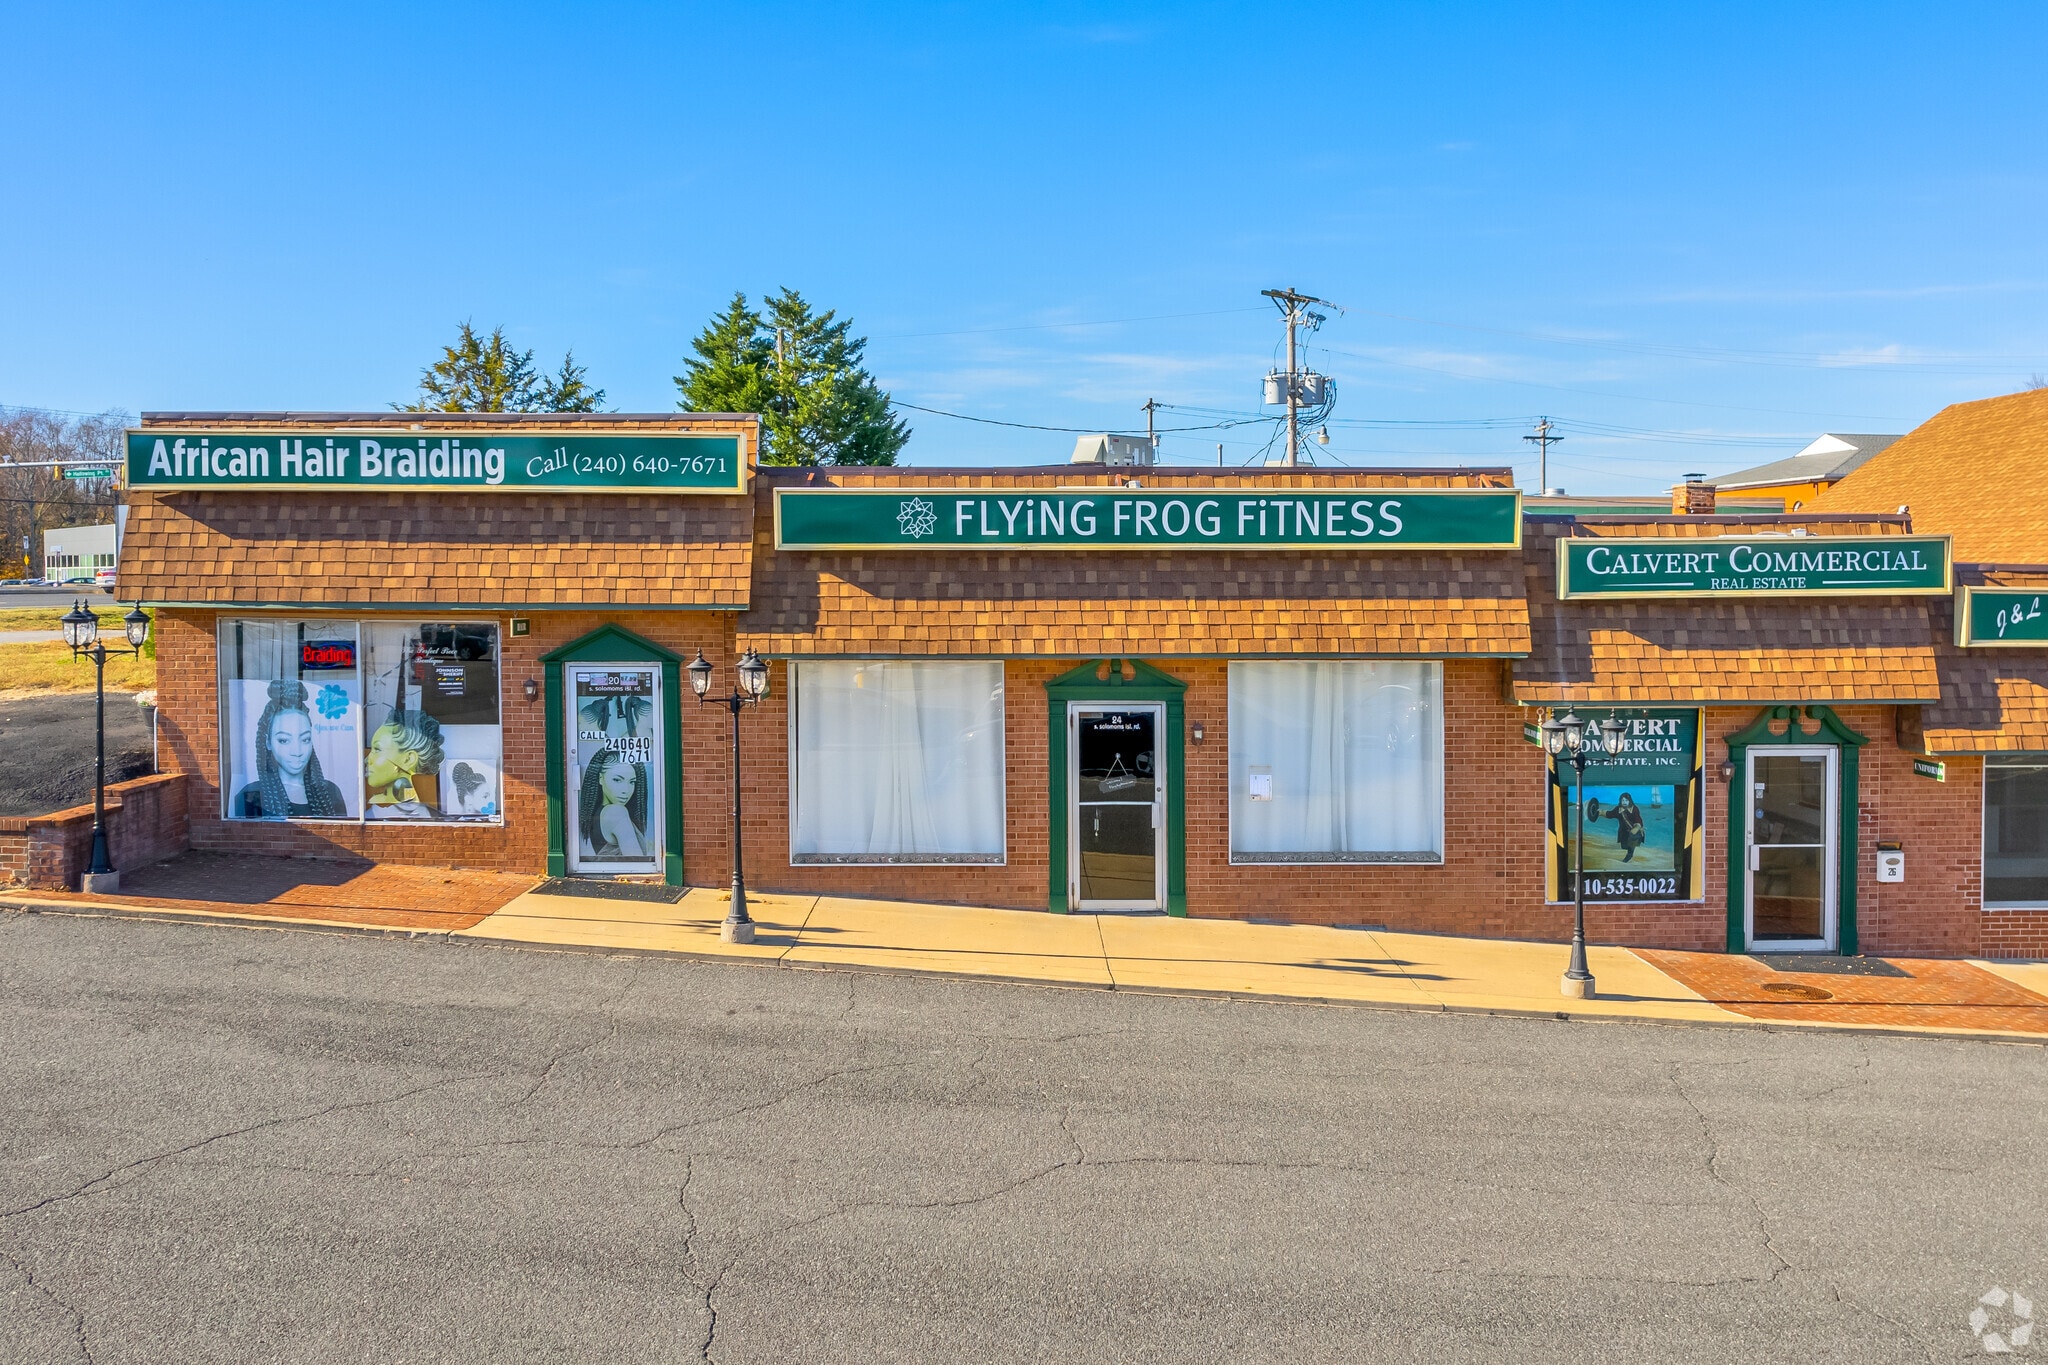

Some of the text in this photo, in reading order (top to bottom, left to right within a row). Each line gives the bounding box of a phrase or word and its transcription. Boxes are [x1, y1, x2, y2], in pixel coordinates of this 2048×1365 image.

[148, 438, 727, 485] African Hair Braiding Call (240) 640-7671
[1113, 500, 1221, 537] FROG
[1586, 545, 1927, 575] CALVERT COMMERCIAL
[1711, 577, 1807, 590] REAL ESTATE
[2010, 603, 2023, 624] &
[2026, 596, 2041, 620] L
[303, 645, 352, 667] Braiding
[608, 676, 620, 685] 20
[1112, 716, 1122, 724] 24
[580, 731, 604, 740] CALL
[605, 738, 650, 750] 240640
[620, 750, 649, 763] 7671
[1655, 757, 1681, 766] INC.
[1888, 867, 1897, 877] 26
[1574, 877, 1676, 895] 10-535-0022
